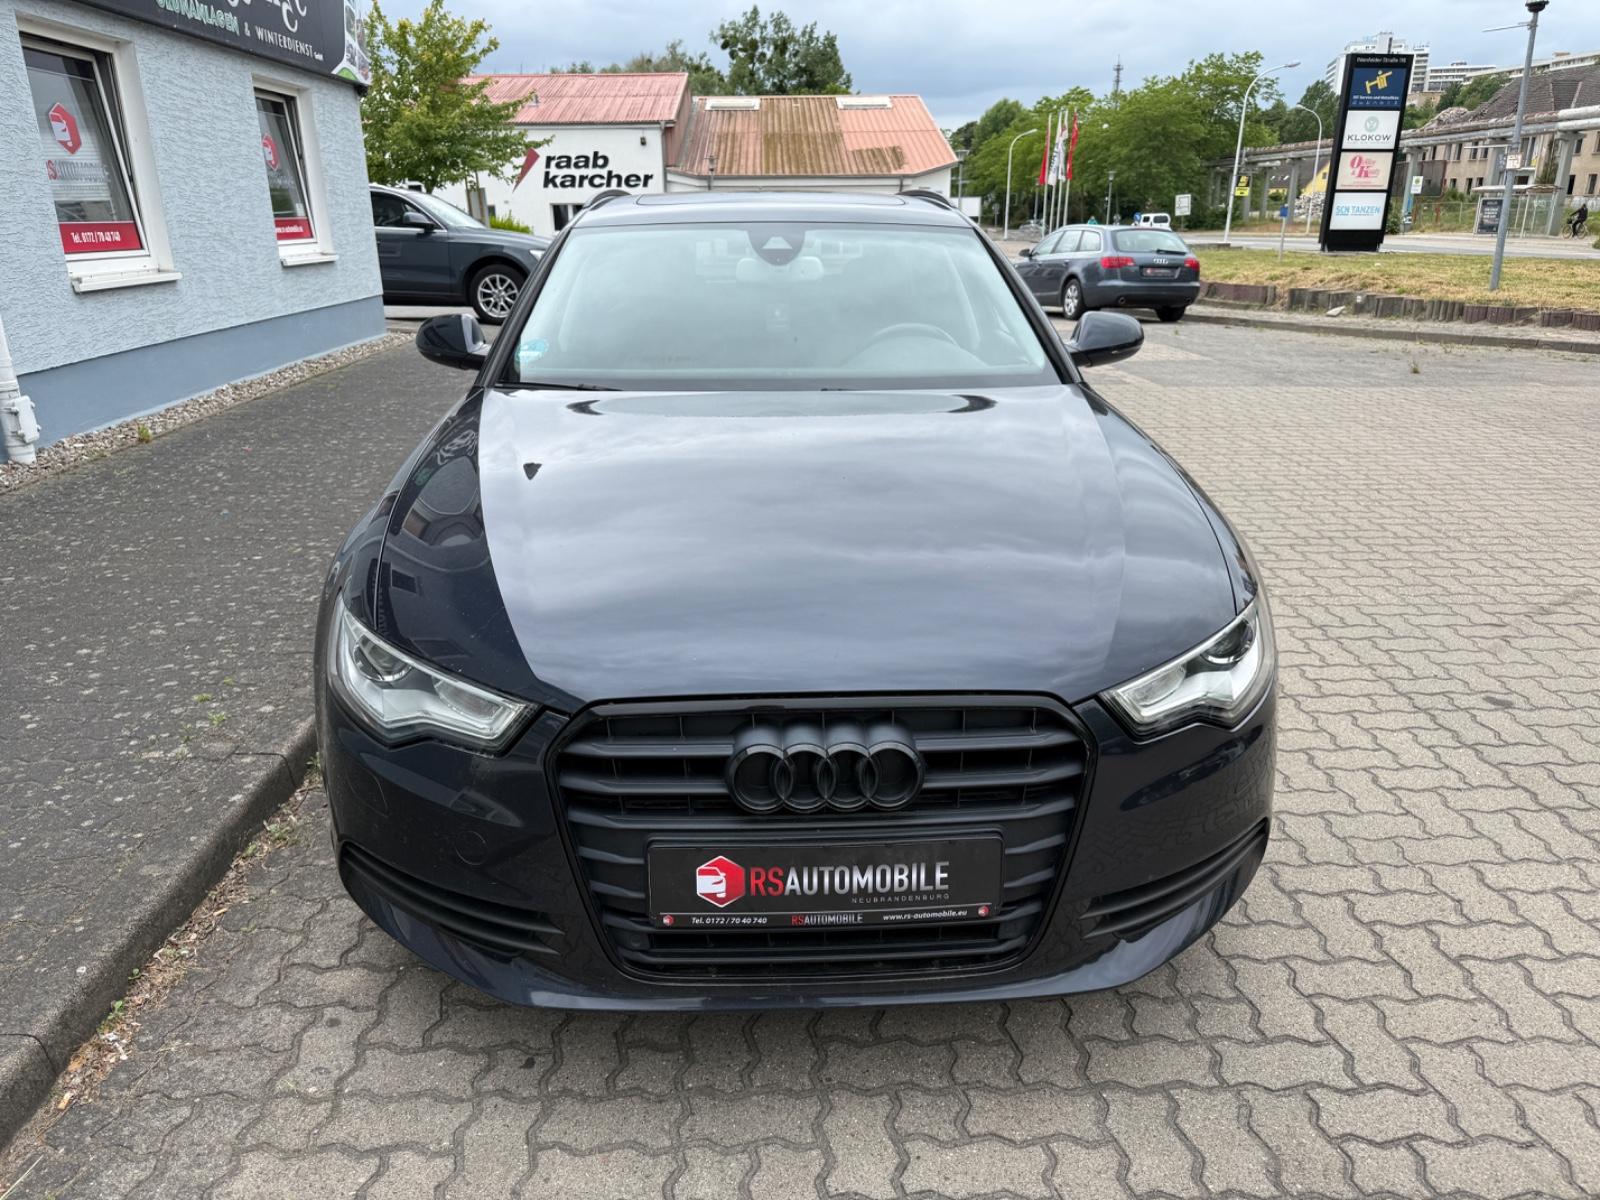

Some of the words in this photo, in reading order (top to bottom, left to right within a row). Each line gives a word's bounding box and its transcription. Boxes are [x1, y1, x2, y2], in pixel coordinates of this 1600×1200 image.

[255, 26, 313, 57] WINTERDIENST
[545, 151, 609, 169] raab
[543, 170, 653, 189] karcher
[1351, 205, 1381, 214] TANZEN
[750, 861, 949, 897] RSAUTOMOBILE
[852, 893, 950, 904] NEUBRANDENBURG
[691, 916, 704, 925] Tel.
[706, 916, 725, 925] 0172
[731, 916, 740, 925] 70
[742, 916, 751, 925] 40
[753, 916, 768, 925] 740
[791, 914, 864, 927] RSAUTOMOBILE
[883, 909, 968, 921] www.rs-automobile.eu
